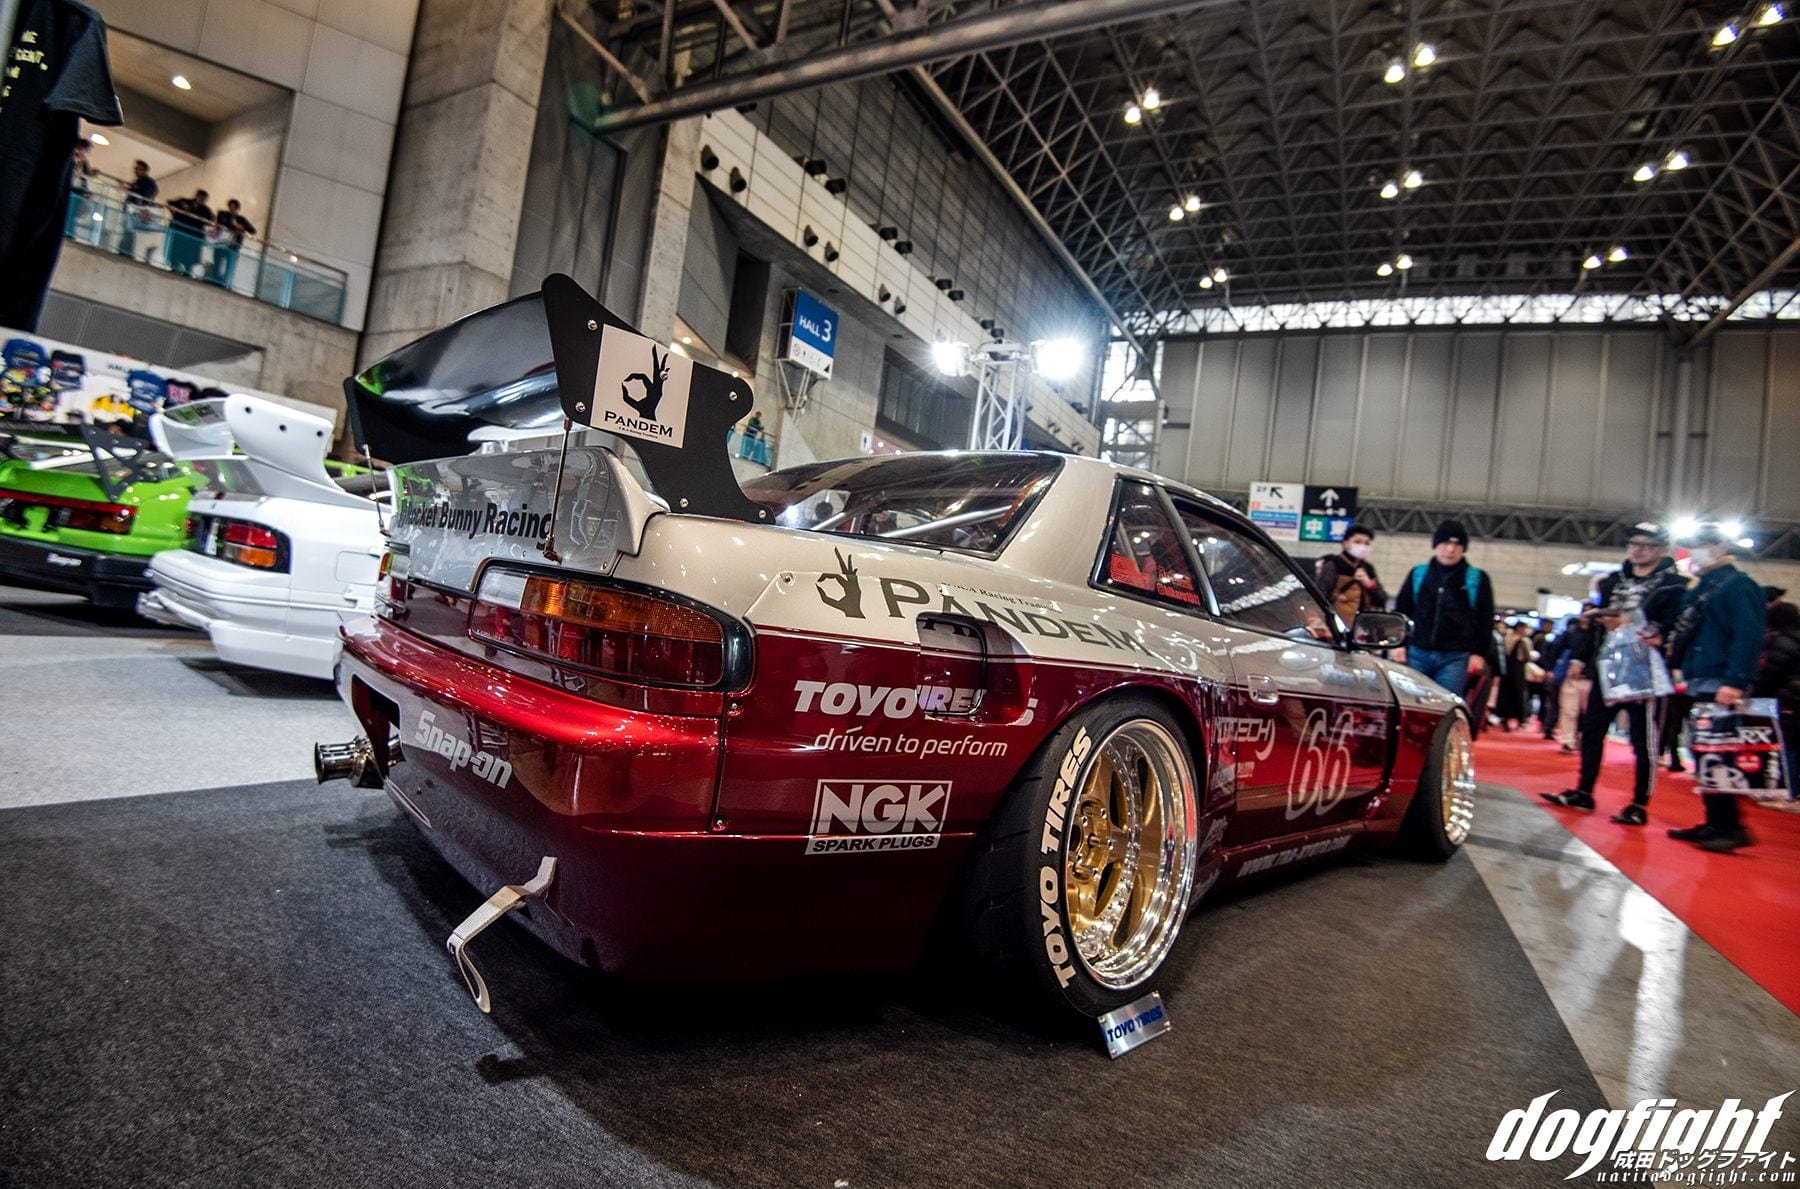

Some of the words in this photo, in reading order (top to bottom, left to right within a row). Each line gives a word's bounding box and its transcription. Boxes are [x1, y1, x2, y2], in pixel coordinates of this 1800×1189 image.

[799, 315, 821, 337] HALL
[820, 319, 832, 342] 3
[438, 502, 483, 540] Bunny
[483, 502, 553, 551] Racing
[978, 588, 1016, 604] Racing
[793, 680, 918, 719] TOYO
[415, 709, 513, 789] Snap-on
[895, 734, 920, 752] to
[919, 735, 1008, 760] perform
[816, 784, 946, 834] NGK
[1040, 726, 1092, 855] TIRES
[812, 838, 876, 853] SPARK
[877, 835, 936, 850] PLUGS
[1040, 865, 1076, 989] TOYO
[1107, 1018, 1136, 1042] TOYO
